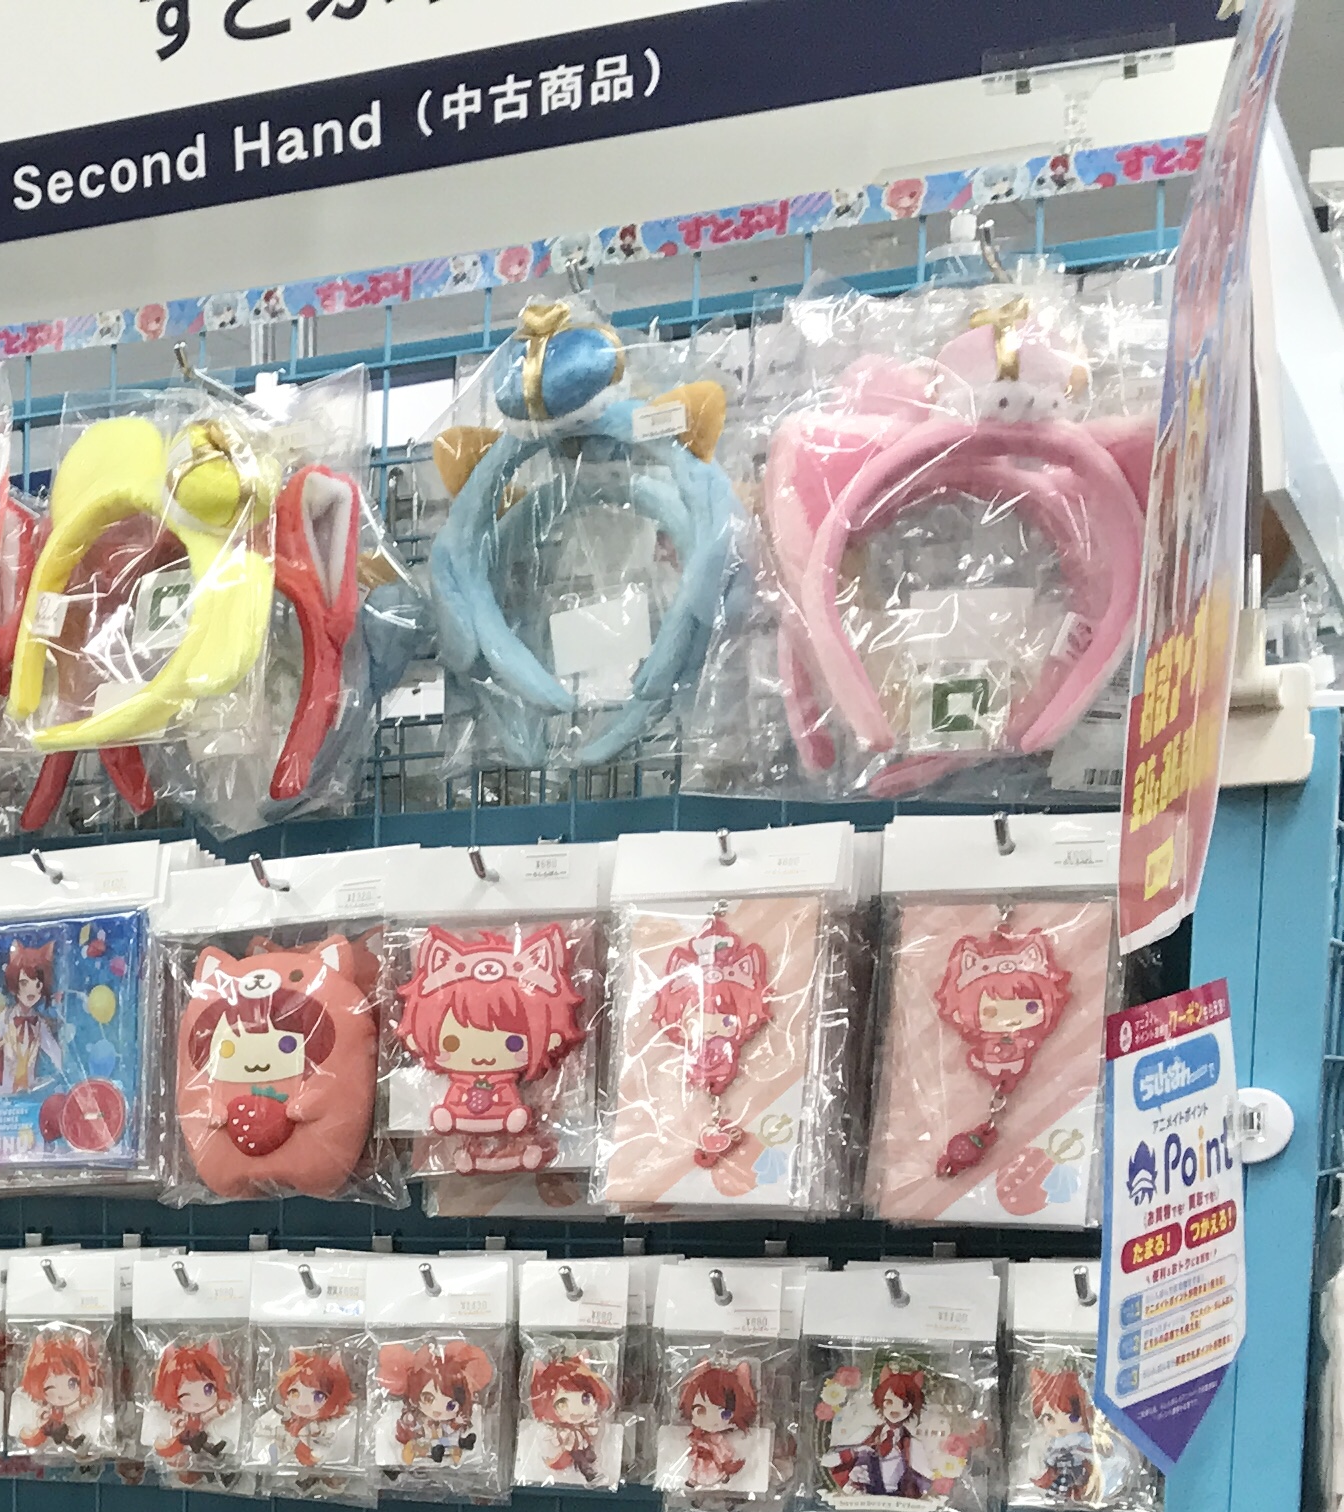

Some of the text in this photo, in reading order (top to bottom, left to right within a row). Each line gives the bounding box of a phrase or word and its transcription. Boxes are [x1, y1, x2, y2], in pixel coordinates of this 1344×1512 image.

[12, 47, 662, 212] Second Hand （中古商品）
[1116, 136, 1207, 180] すとぷ
[678, 198, 790, 249] すとぷり
[316, 266, 413, 312] すとぷり
[1152, 1106, 1209, 1134] アニメイトポイント
[1164, 1116, 1234, 1195] Point
[1132, 1205, 1232, 1265] たまる! つかえる!
